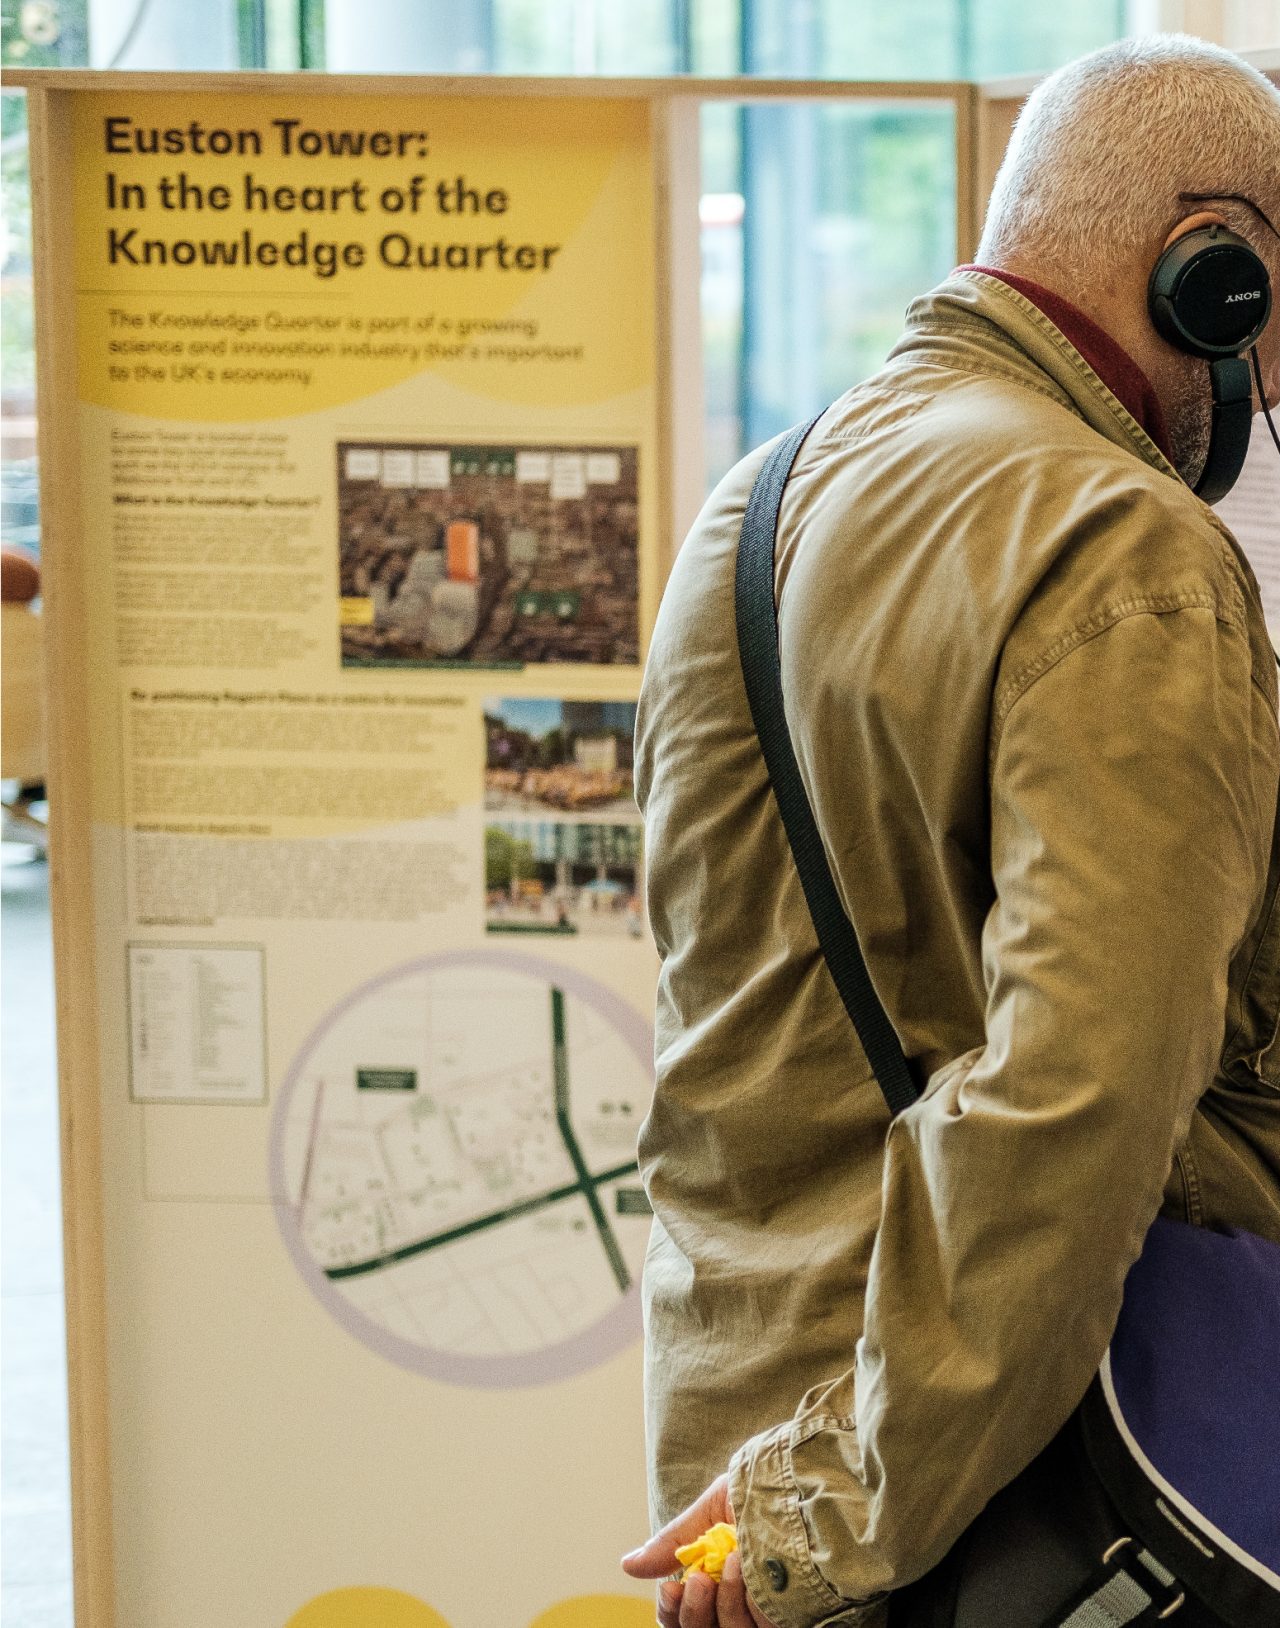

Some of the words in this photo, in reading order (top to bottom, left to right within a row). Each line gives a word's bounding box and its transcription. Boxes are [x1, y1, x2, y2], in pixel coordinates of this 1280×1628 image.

[104, 116, 262, 157] Euston
[271, 117, 429, 160] Tower:
[105, 172, 146, 211] In
[157, 171, 231, 212] the
[243, 172, 367, 214] heart
[379, 174, 427, 215] of
[435, 175, 509, 216] the
[107, 227, 366, 281] Knowledge
[378, 231, 561, 272] Quarter
[1224, 290, 1261, 304] SONY
[108, 308, 145, 329] The
[149, 311, 261, 336] Knowledge
[264, 311, 342, 333] Quarter
[367, 316, 410, 337] part
[108, 338, 185, 356] science
[188, 338, 227, 356] and
[134, 364, 166, 383] the
